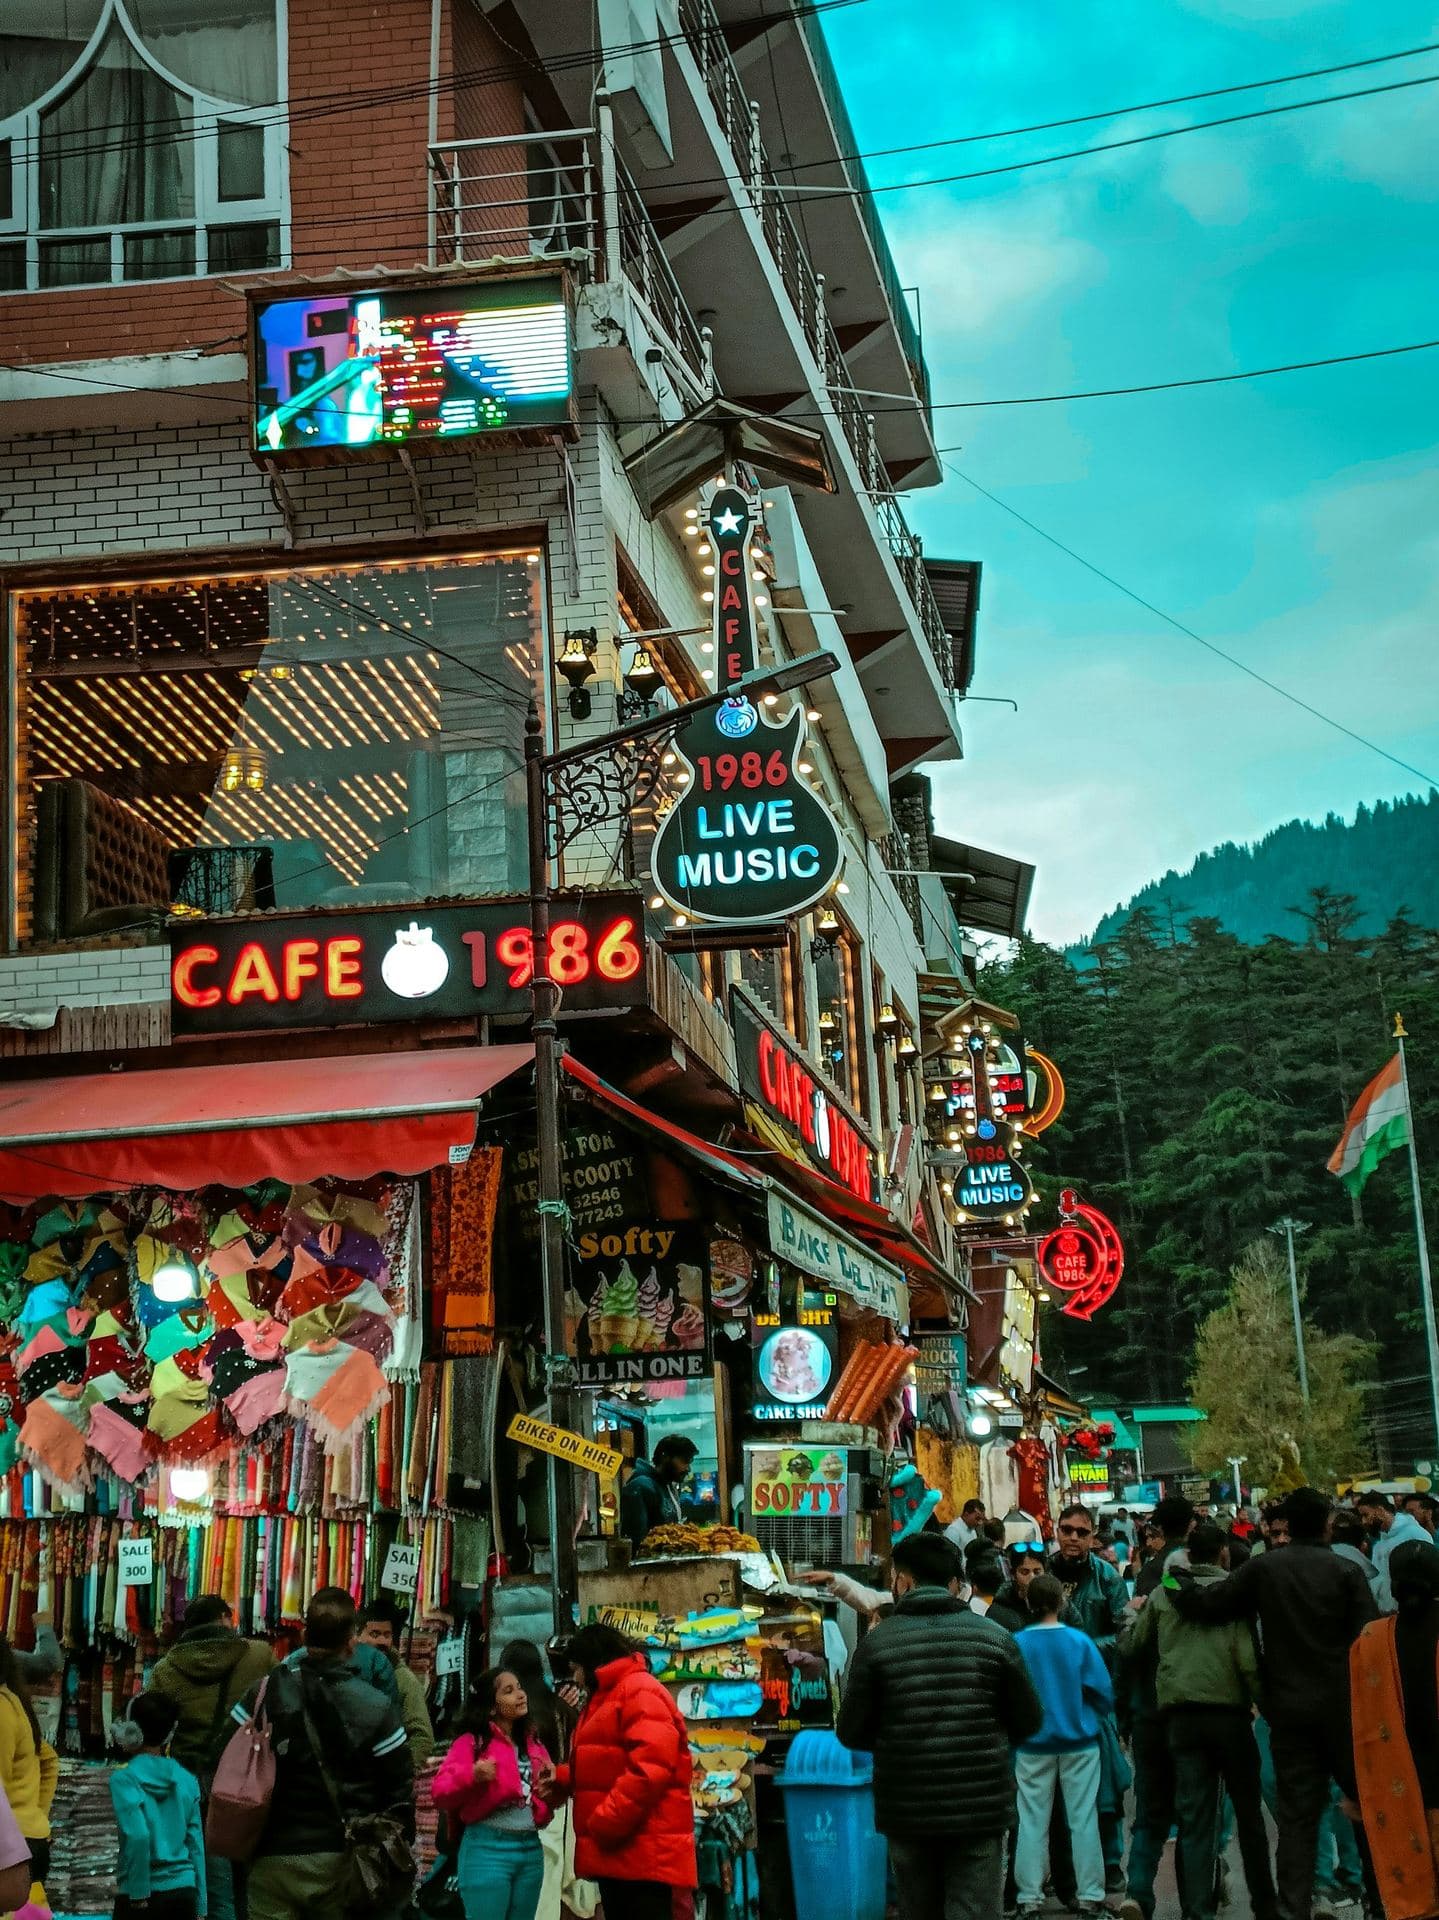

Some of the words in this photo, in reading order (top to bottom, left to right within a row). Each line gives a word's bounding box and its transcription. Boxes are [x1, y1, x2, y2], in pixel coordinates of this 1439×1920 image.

[721, 549, 742, 679] CAFE
[697, 750, 788, 791] 1986
[697, 799, 796, 840] LIVE
[677, 844, 821, 889] MUSIC
[173, 937, 364, 1007] CAFE
[460, 919, 641, 989] 1986
[758, 1029, 816, 1145] CAFE
[576, 1133, 616, 1157] FOR
[967, 1146, 1006, 1163] 1986
[969, 1164, 1012, 1185] LIVE
[961, 1183, 1024, 1206] MUSIC
[579, 1226, 676, 1260] Softy
[780, 1203, 830, 1266] BAKE
[1056, 1255, 1087, 1269] CAFE
[1058, 1268, 1087, 1282] 1986
[921, 1337, 953, 1349] HOTEL
[617, 1359, 644, 1379] IN
[650, 1355, 704, 1378] ONE
[920, 1349, 959, 1364] ROCK
[755, 1404, 794, 1421] CAKE
[796, 1403, 827, 1421] SHO
[516, 1419, 557, 1444] BIKES
[559, 1436, 580, 1453] ON
[581, 1445, 617, 1468] HIRE
[755, 1482, 845, 1512] SOFTY
[122, 1545, 151, 1557] SALE
[390, 1550, 416, 1566] SAL
[125, 1565, 147, 1577] 300
[447, 1656, 461, 1669] 15
[759, 1667, 790, 1717] kery
